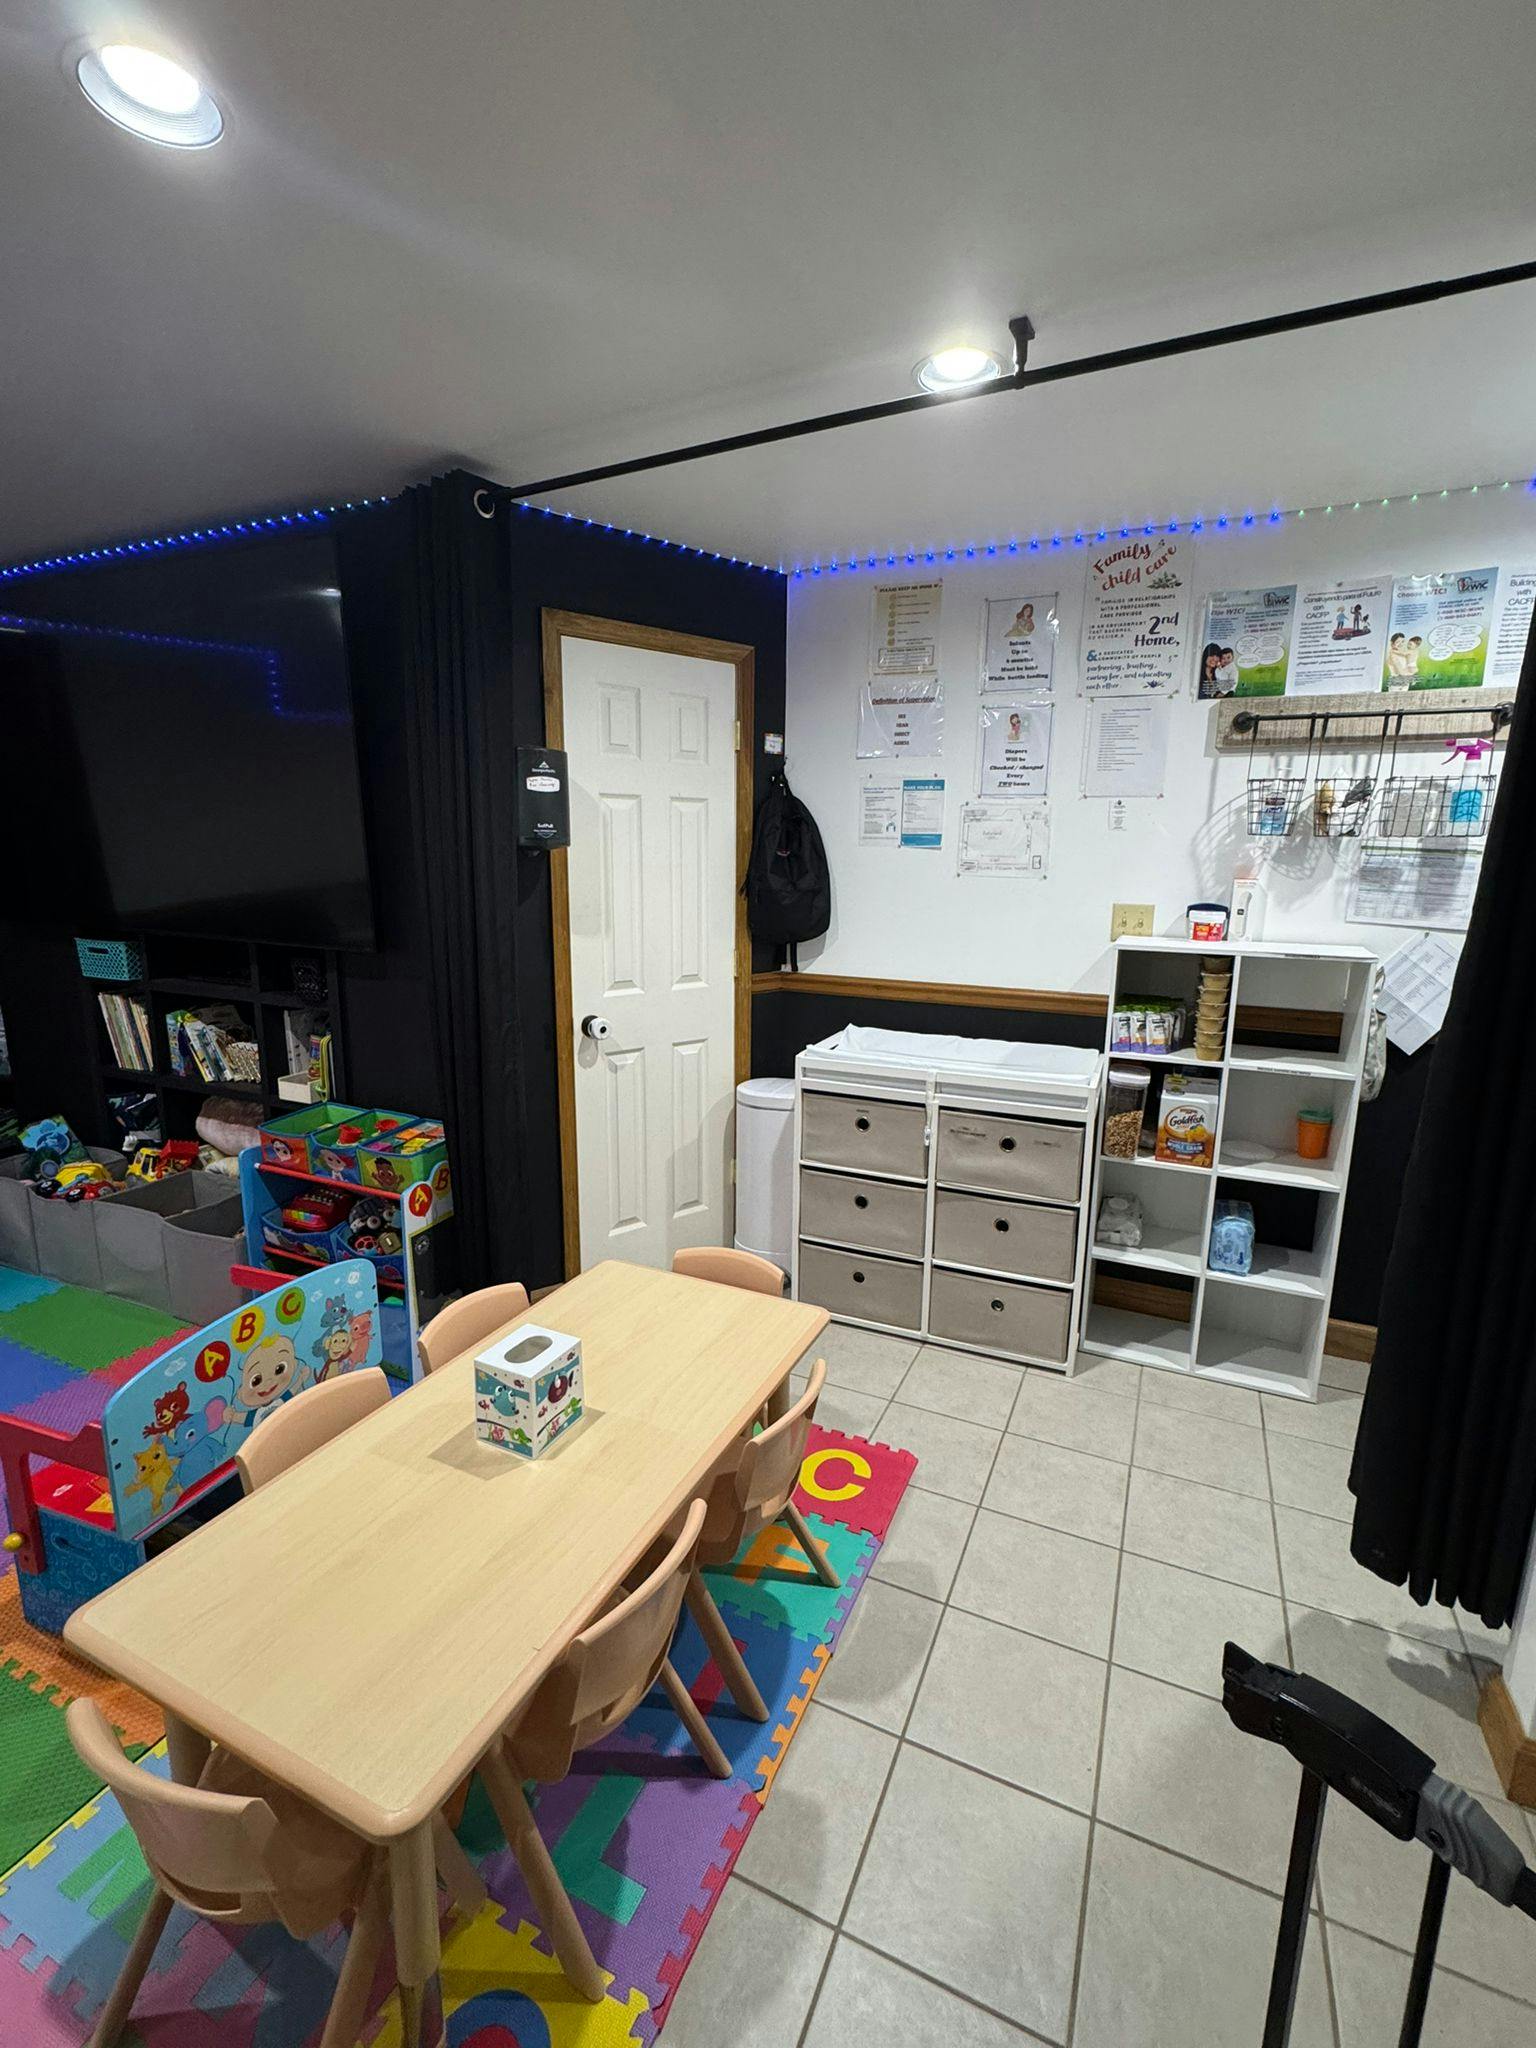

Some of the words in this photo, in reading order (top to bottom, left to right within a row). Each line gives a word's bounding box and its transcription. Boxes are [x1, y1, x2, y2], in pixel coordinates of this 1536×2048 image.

[1093, 543, 1152, 574] Family
[1102, 567, 1140, 591] child
[1145, 544, 1177, 576] care
[1471, 579, 1489, 591] WIC
[1148, 612, 1179, 635] 2nd
[1134, 634, 1180, 647] Home,
[1086, 650, 1098, 662] &
[1169, 1114, 1205, 1127] Goldfish
[203, 1348, 225, 1377] A
[235, 1312, 257, 1343] B
[281, 1293, 301, 1316] C
[800, 1448, 872, 1502] C
